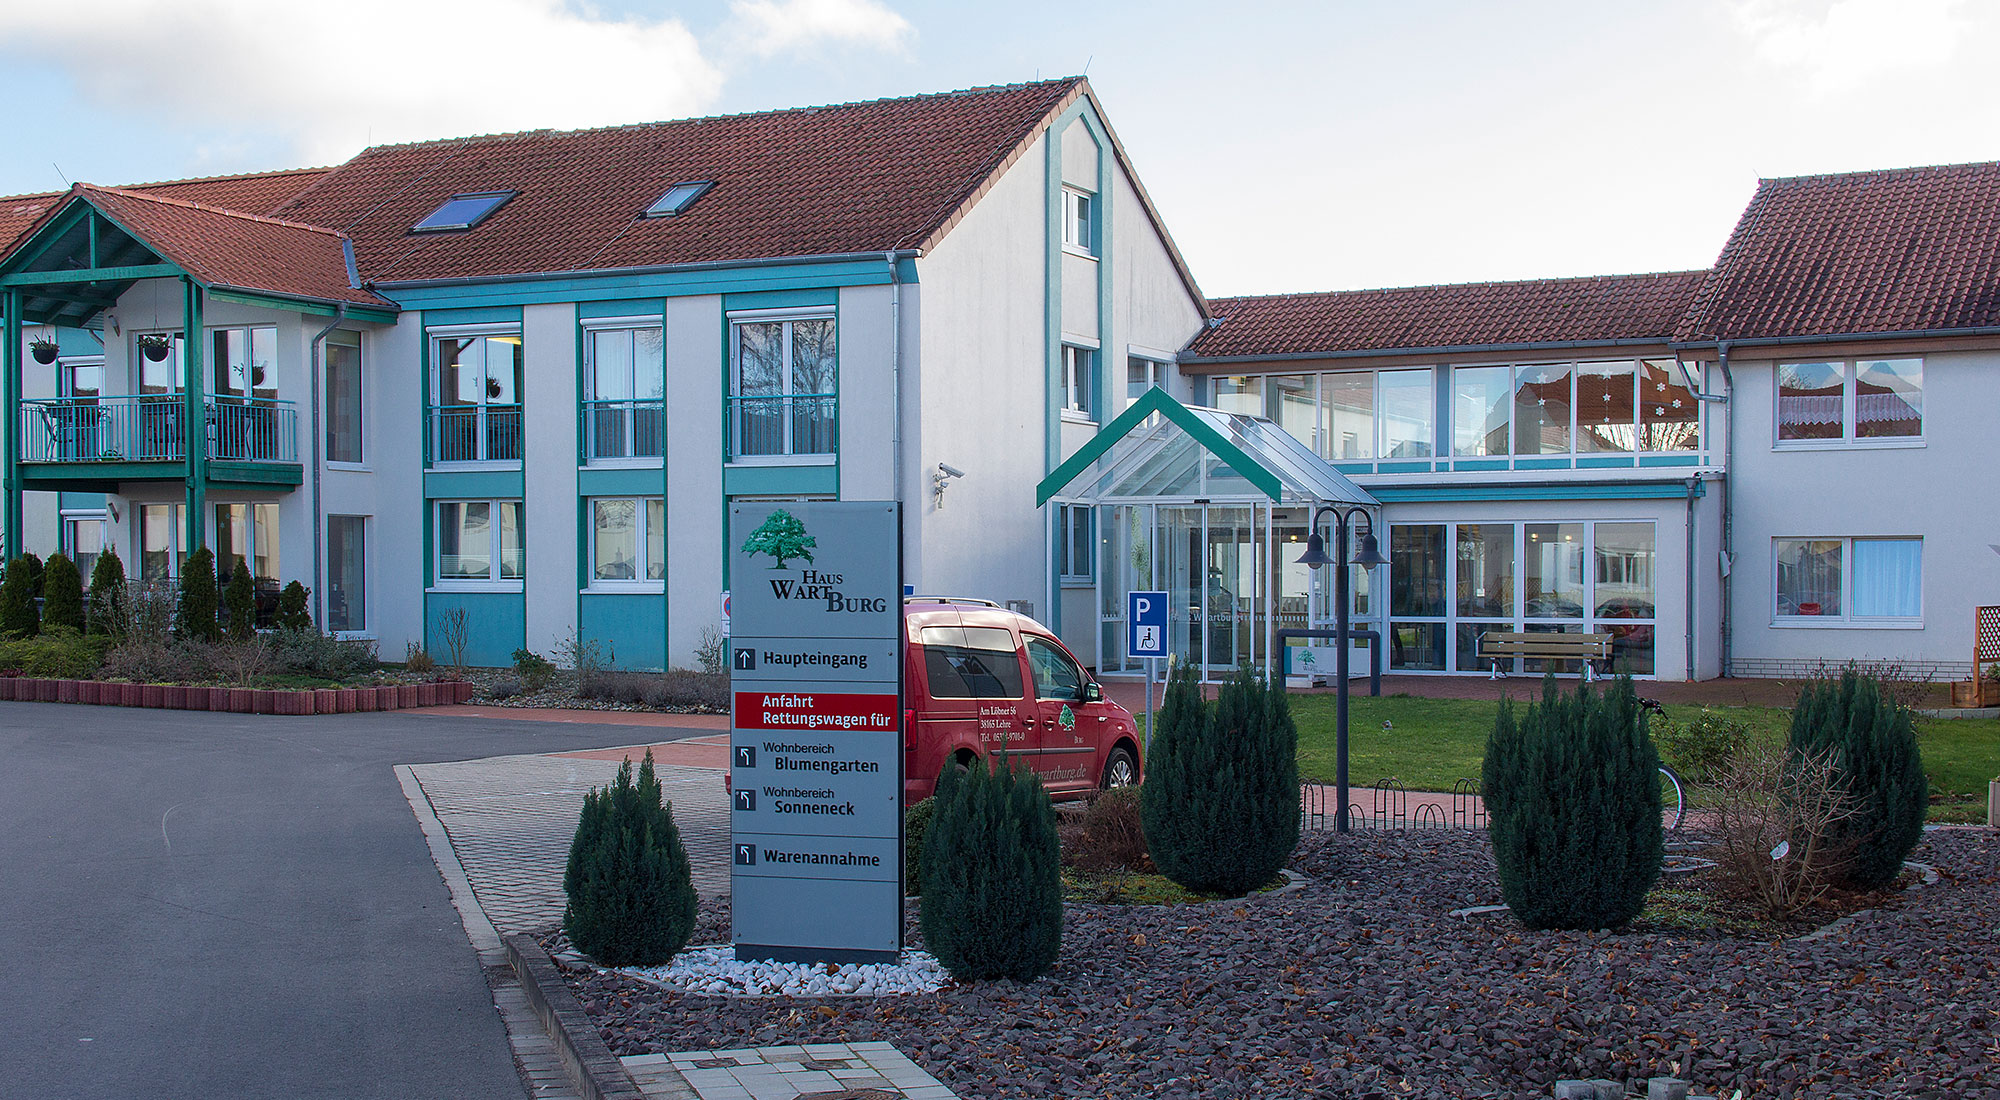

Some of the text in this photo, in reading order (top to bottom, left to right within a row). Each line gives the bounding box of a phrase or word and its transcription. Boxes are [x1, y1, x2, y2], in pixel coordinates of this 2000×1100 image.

[1136, 598, 1151, 622] P
[764, 651, 868, 669] Haupteingang
[762, 695, 814, 708] Anfahrt
[980, 707, 990, 715] Am
[1010, 706, 1017, 715] 56
[763, 711, 891, 728] Rettungswagen für
[996, 719, 1011, 728] Lehre
[980, 733, 991, 742] Tel.
[763, 742, 835, 754] Wohnbereich
[775, 757, 879, 775] Blumengarten
[763, 786, 835, 799] Wohnbereich
[774, 801, 855, 816] Sonneneck
[764, 850, 880, 867] Warenannahme
